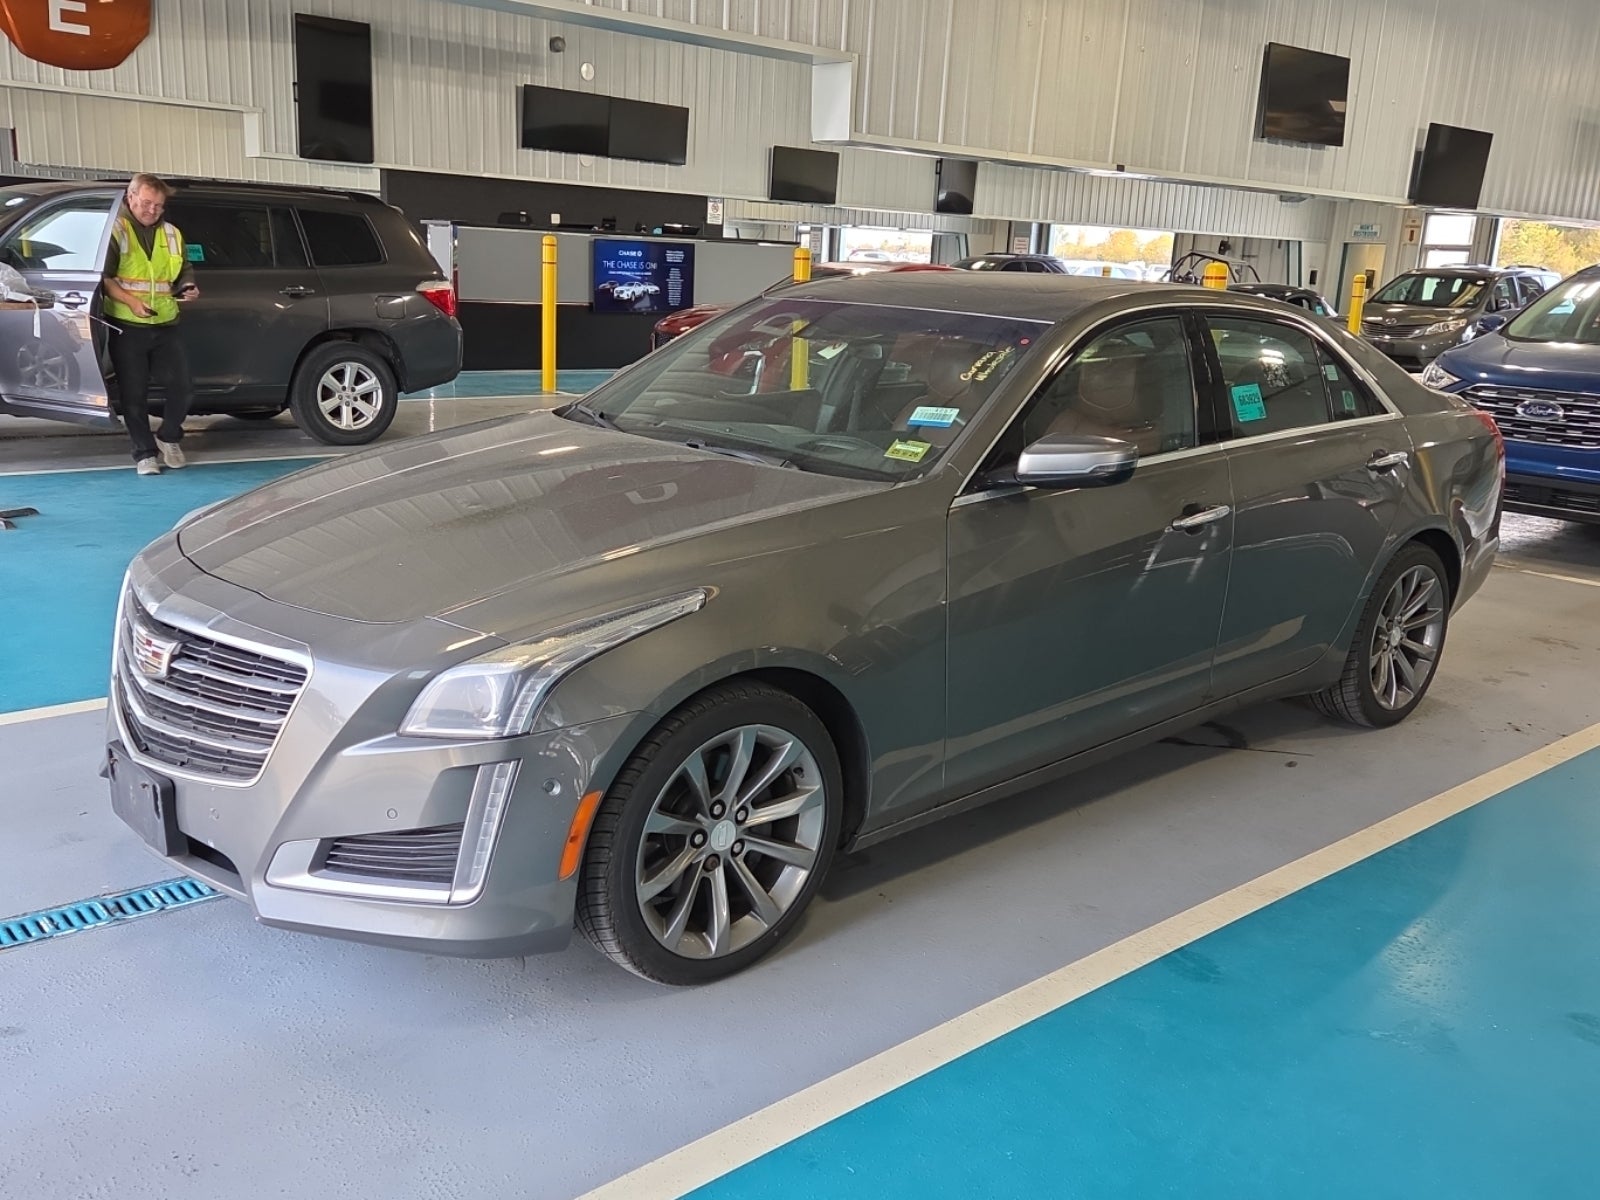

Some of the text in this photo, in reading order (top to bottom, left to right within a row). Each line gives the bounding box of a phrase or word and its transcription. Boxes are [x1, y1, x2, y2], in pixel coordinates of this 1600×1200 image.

[602, 260, 615, 269] THE
[616, 261, 637, 269] CHASE
[1526, 404, 1552, 415] Ford
